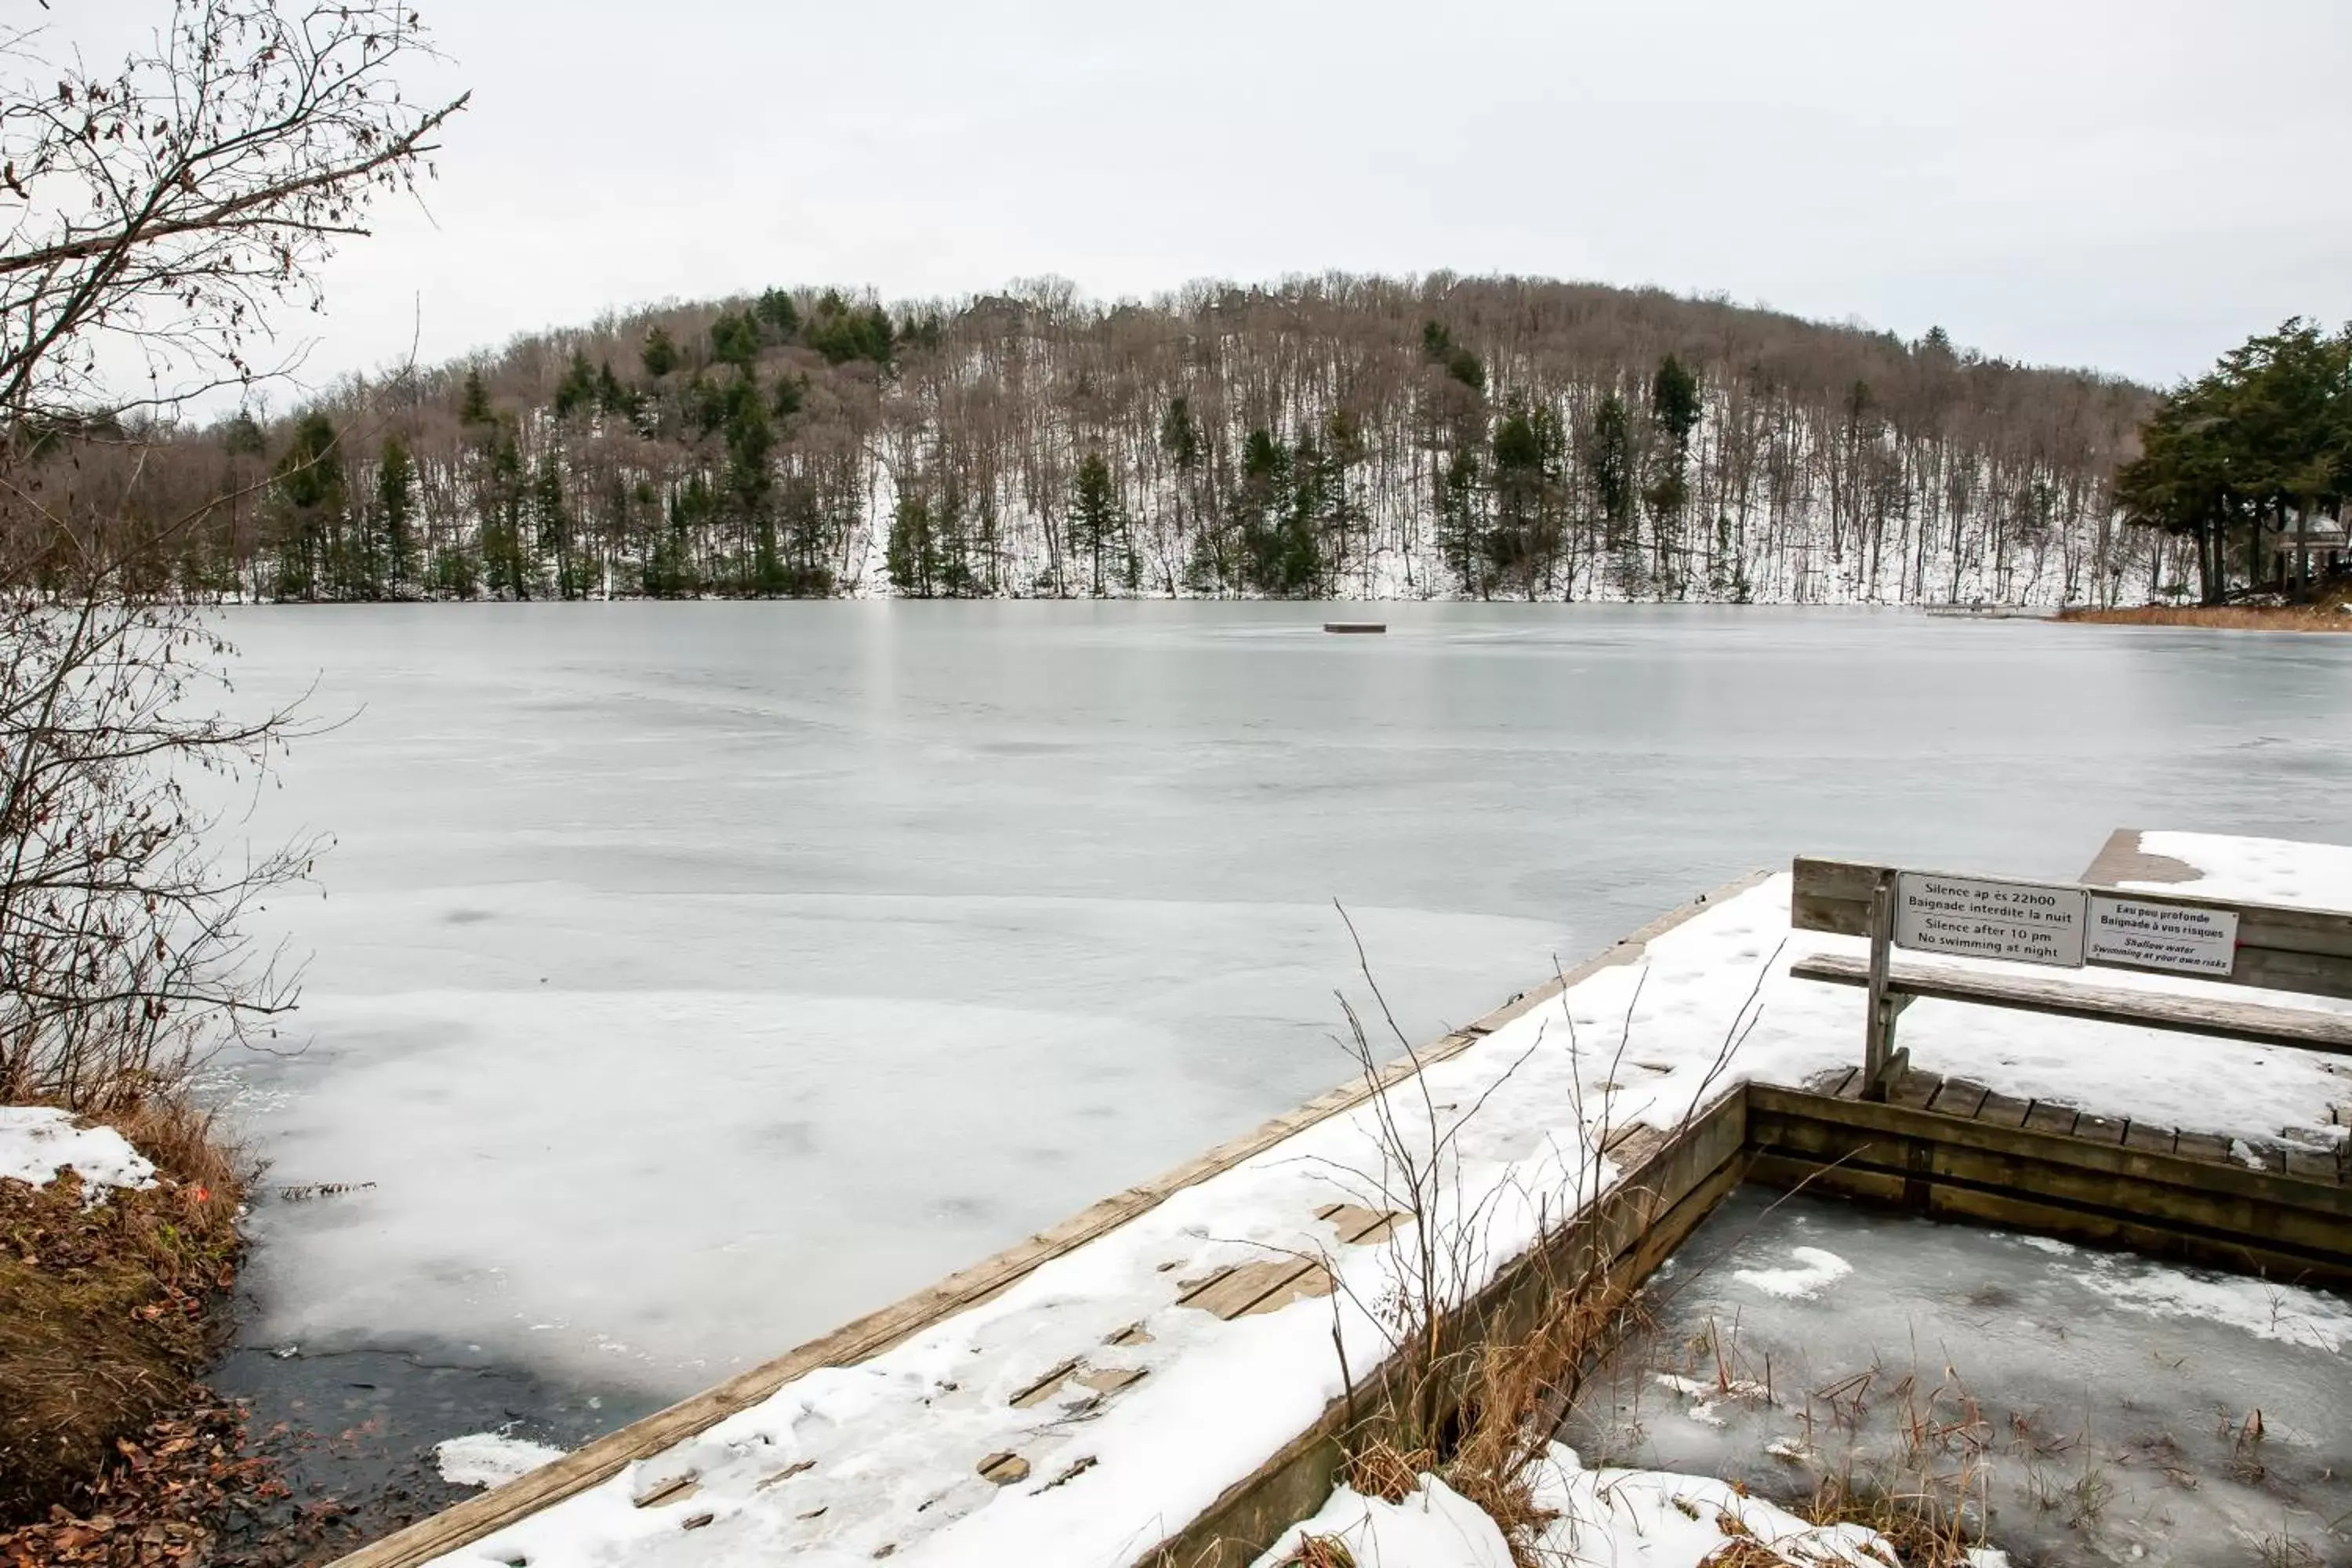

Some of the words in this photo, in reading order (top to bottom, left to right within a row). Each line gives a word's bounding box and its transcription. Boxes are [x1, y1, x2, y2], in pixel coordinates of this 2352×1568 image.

[1926, 883, 1969, 898] Silence
[2013, 893, 2056, 906] 22h00
[1909, 895, 1965, 911] Baignade
[1970, 902, 2024, 917] interdite
[2030, 909, 2040, 920] la
[2045, 912, 2071, 923] nuit
[2117, 905, 2136, 914] Eau
[2161, 911, 2209, 923] profonde
[1926, 918, 1969, 933] Silence
[1974, 924, 2005, 936] after
[2012, 929, 2027, 938] 10
[2031, 932, 2052, 942] pm
[2101, 916, 2150, 929] Baignade
[2152, 921, 2158, 931] à
[2162, 924, 2180, 933] vos
[2183, 926, 2223, 938] risques
[1918, 933, 1935, 942] No
[1940, 935, 2002, 953] swimming
[2007, 942, 2020, 952] at
[2024, 942, 2058, 957] night
[2092, 945, 2141, 958] Swimming
[2155, 953, 2177, 962] your
[2202, 960, 2227, 968] risks
[2124, 938, 2164, 949] Shallow
[2166, 945, 2195, 954] water
